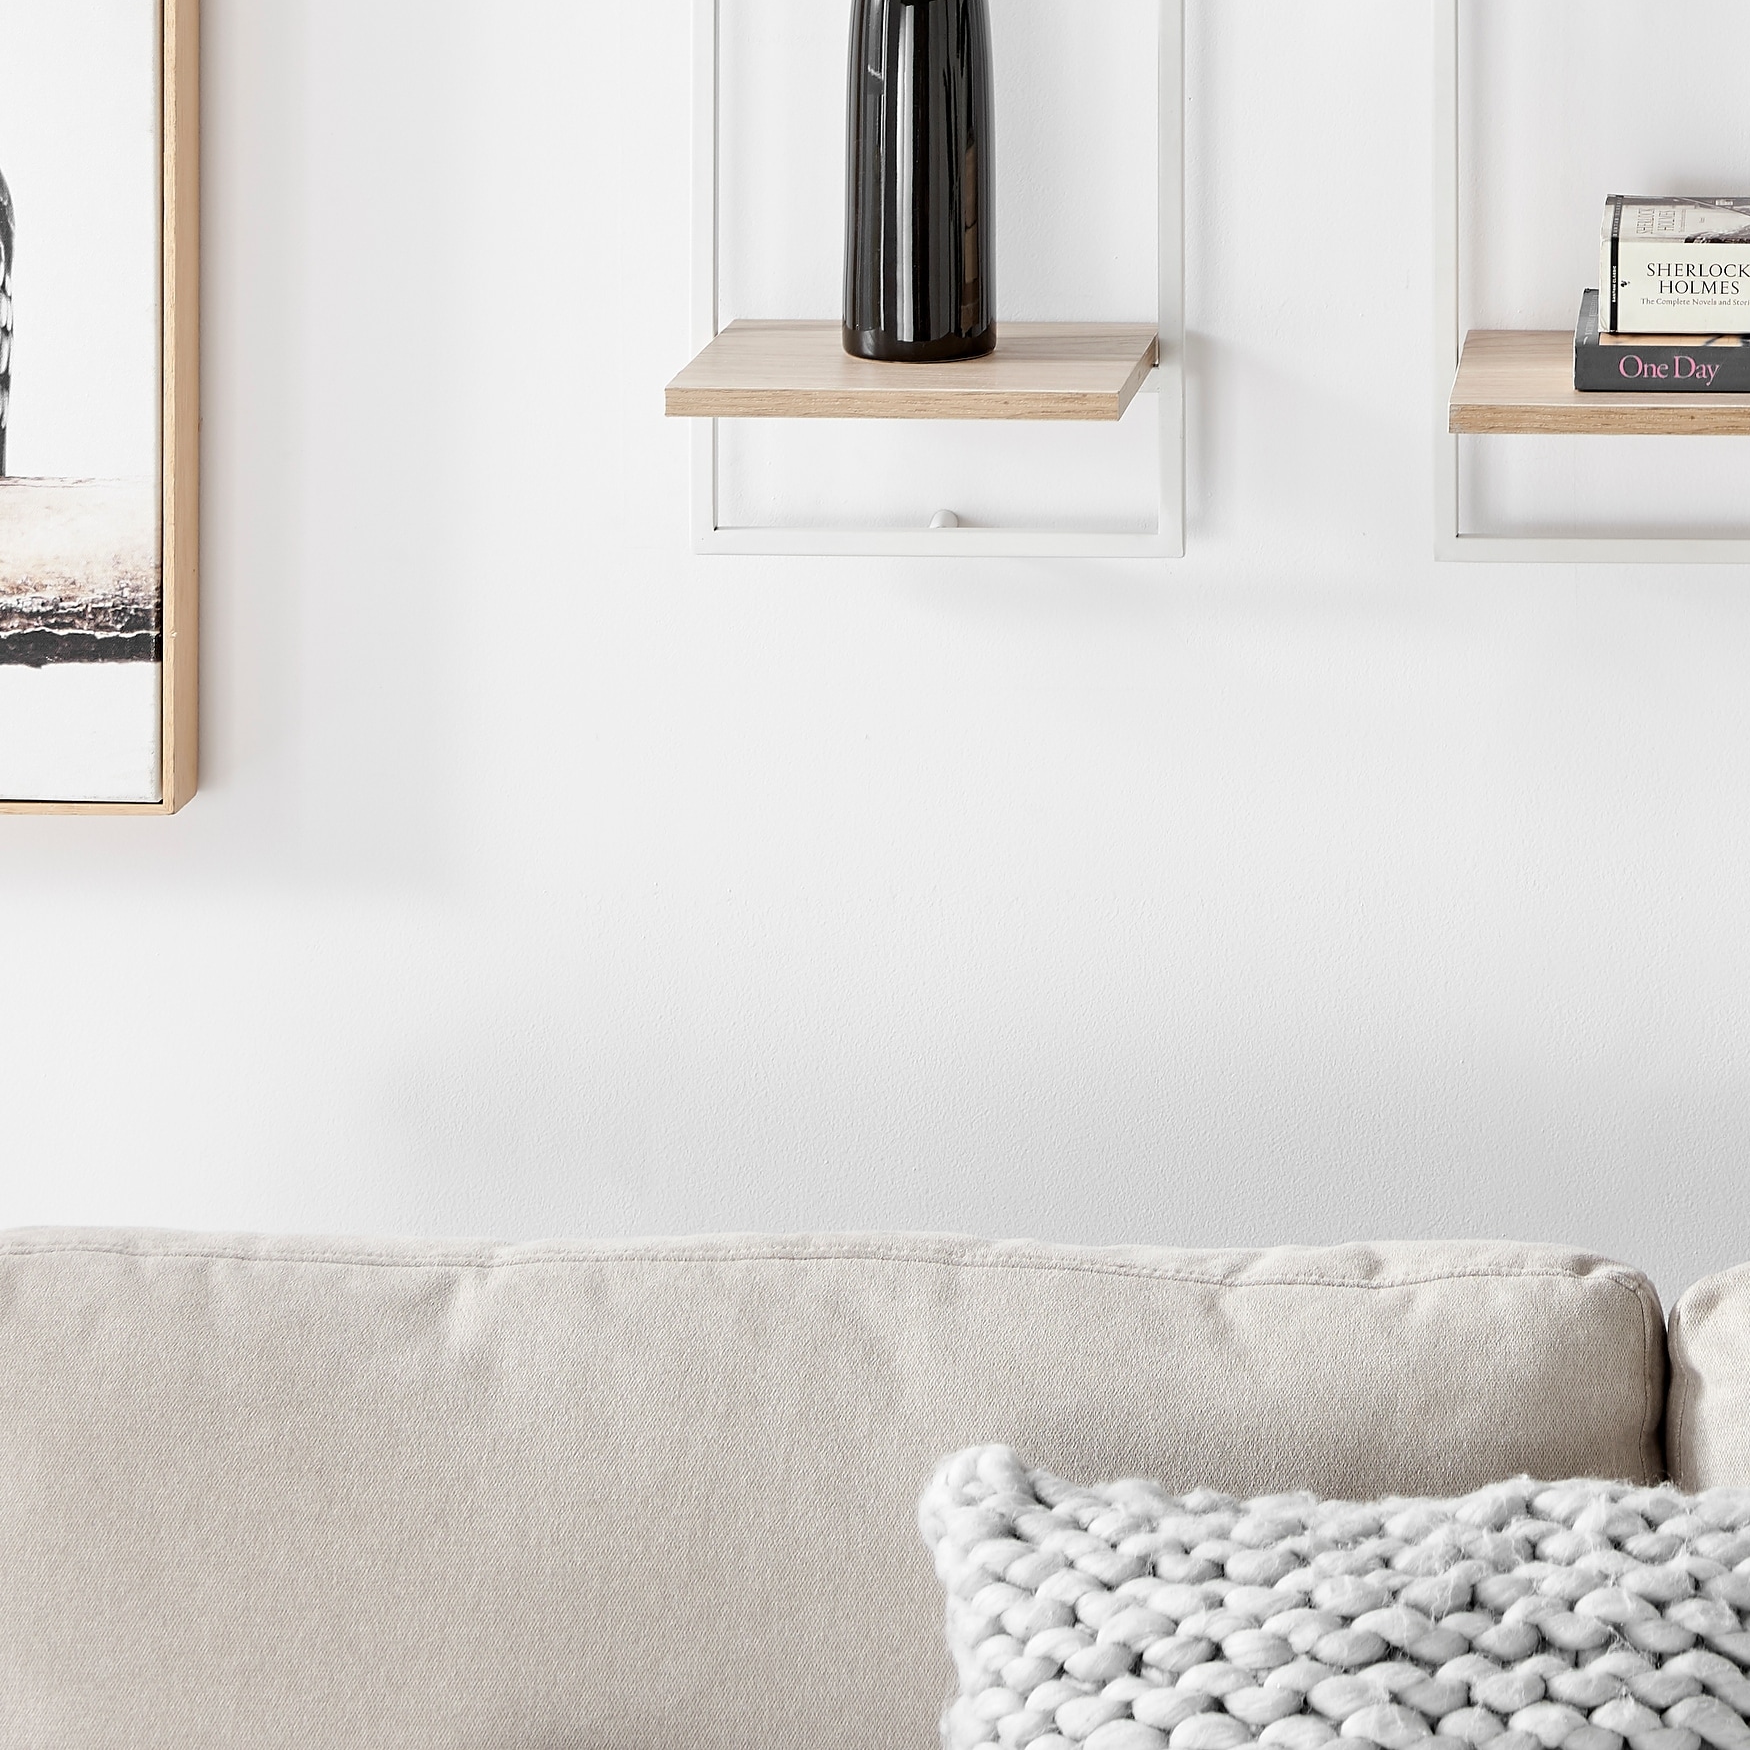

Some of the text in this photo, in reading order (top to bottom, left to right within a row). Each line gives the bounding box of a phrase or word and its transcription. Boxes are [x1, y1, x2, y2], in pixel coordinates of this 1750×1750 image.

[1646, 263, 1750, 278] SHERLOCK
[1659, 280, 1740, 295] HOLMES
[1656, 298, 1690, 307] Complete
[1692, 298, 1717, 306] Novels
[1718, 298, 1732, 306] and
[1618, 354, 1721, 386] One Day
